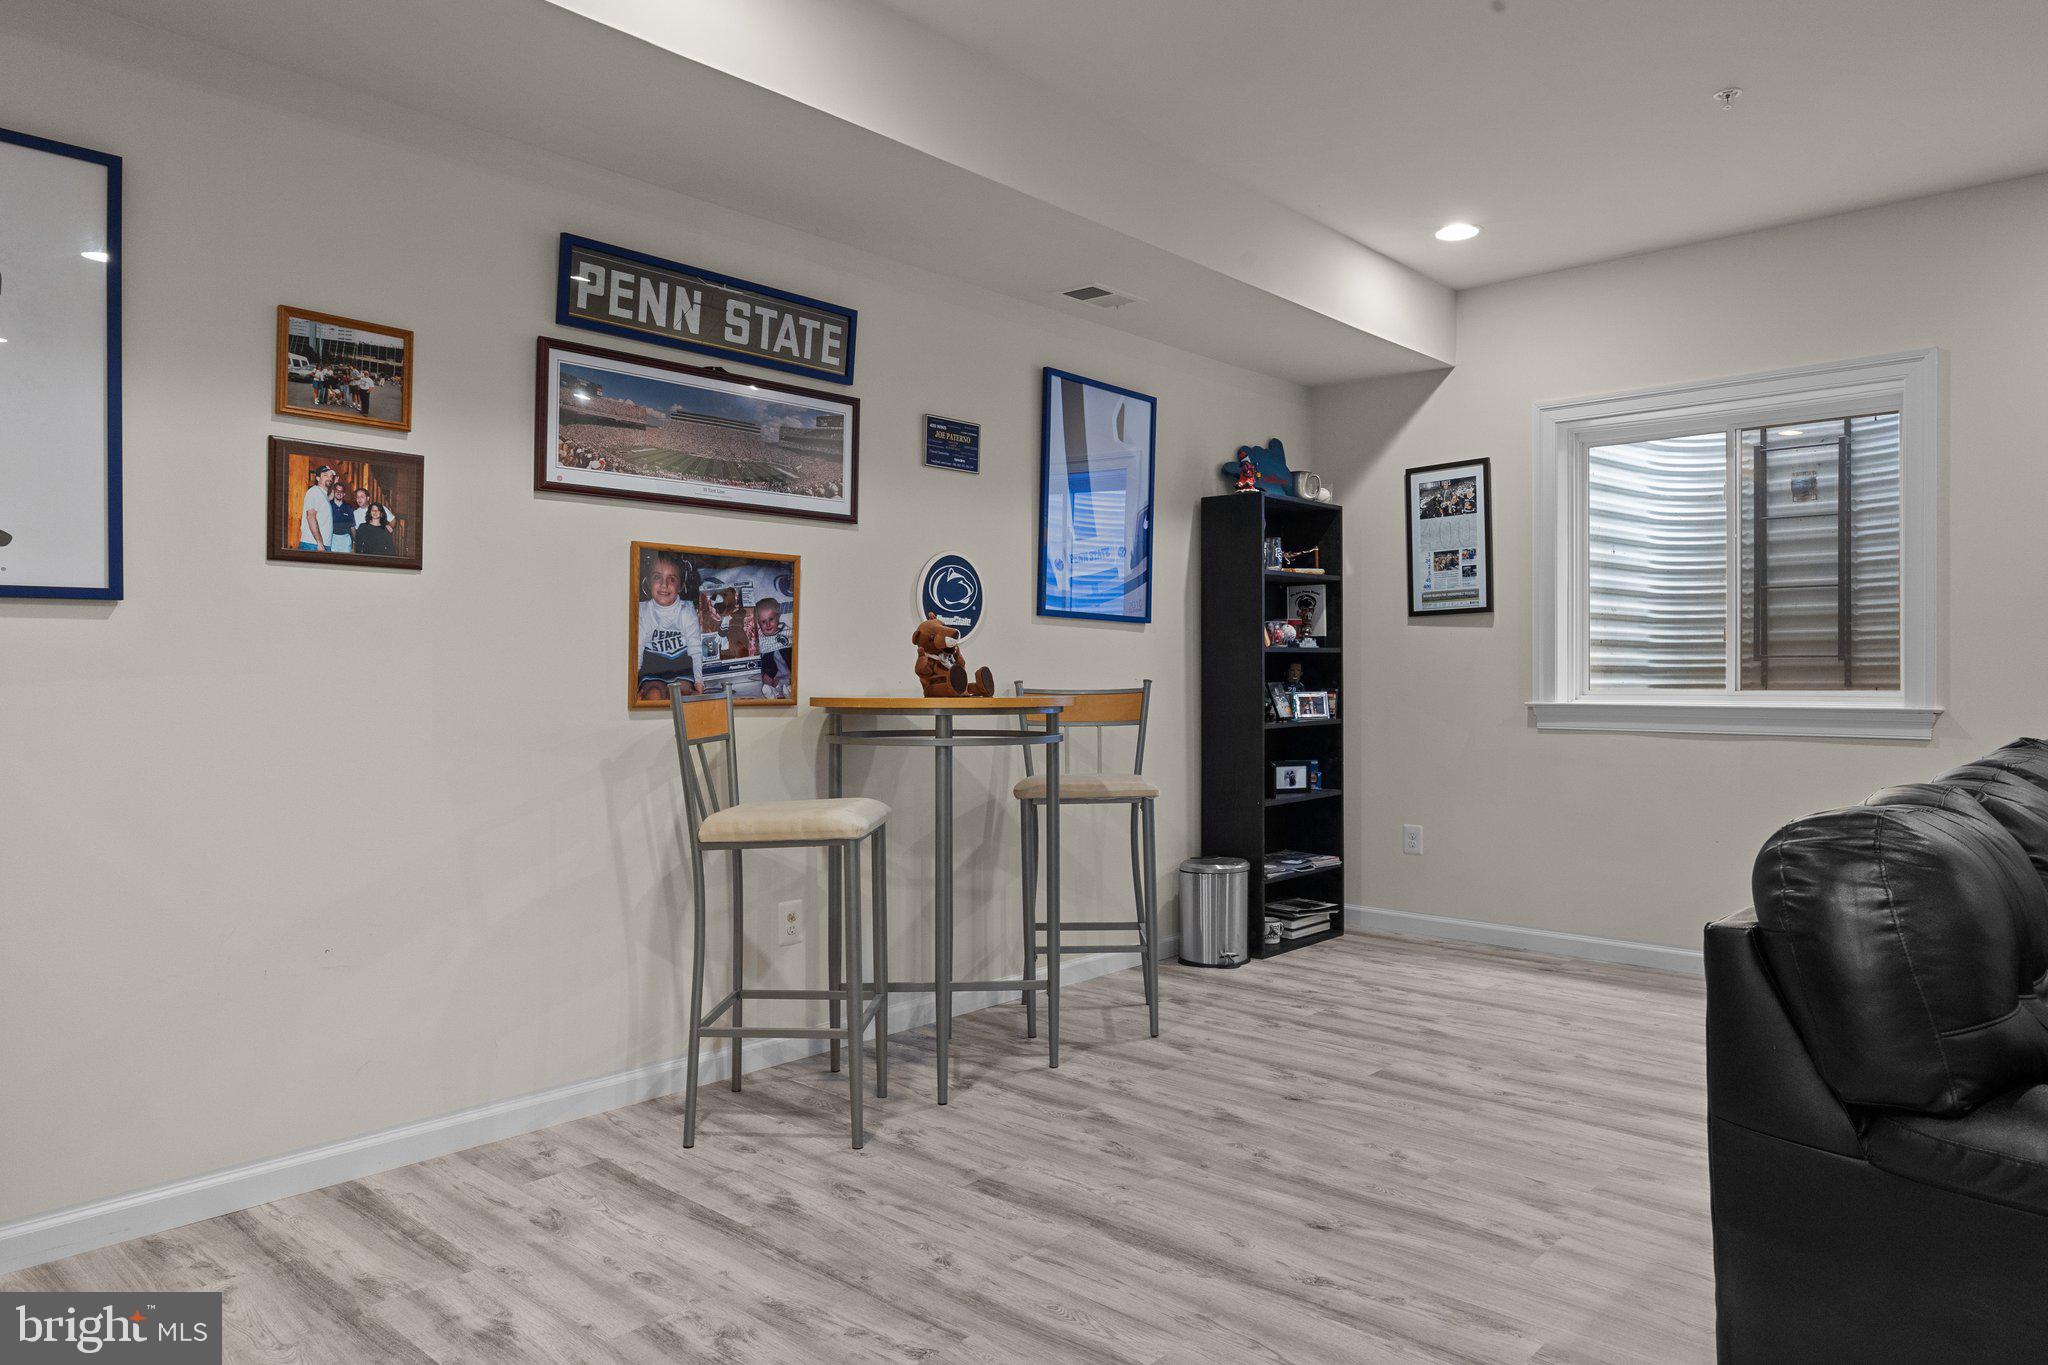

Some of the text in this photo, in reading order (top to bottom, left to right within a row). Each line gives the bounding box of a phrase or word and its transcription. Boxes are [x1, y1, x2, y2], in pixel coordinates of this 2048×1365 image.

[576, 261, 842, 366] PENN STATE
[934, 431, 945, 439] JOE
[946, 433, 971, 444] PATERNO
[651, 636, 684, 652] STATE
